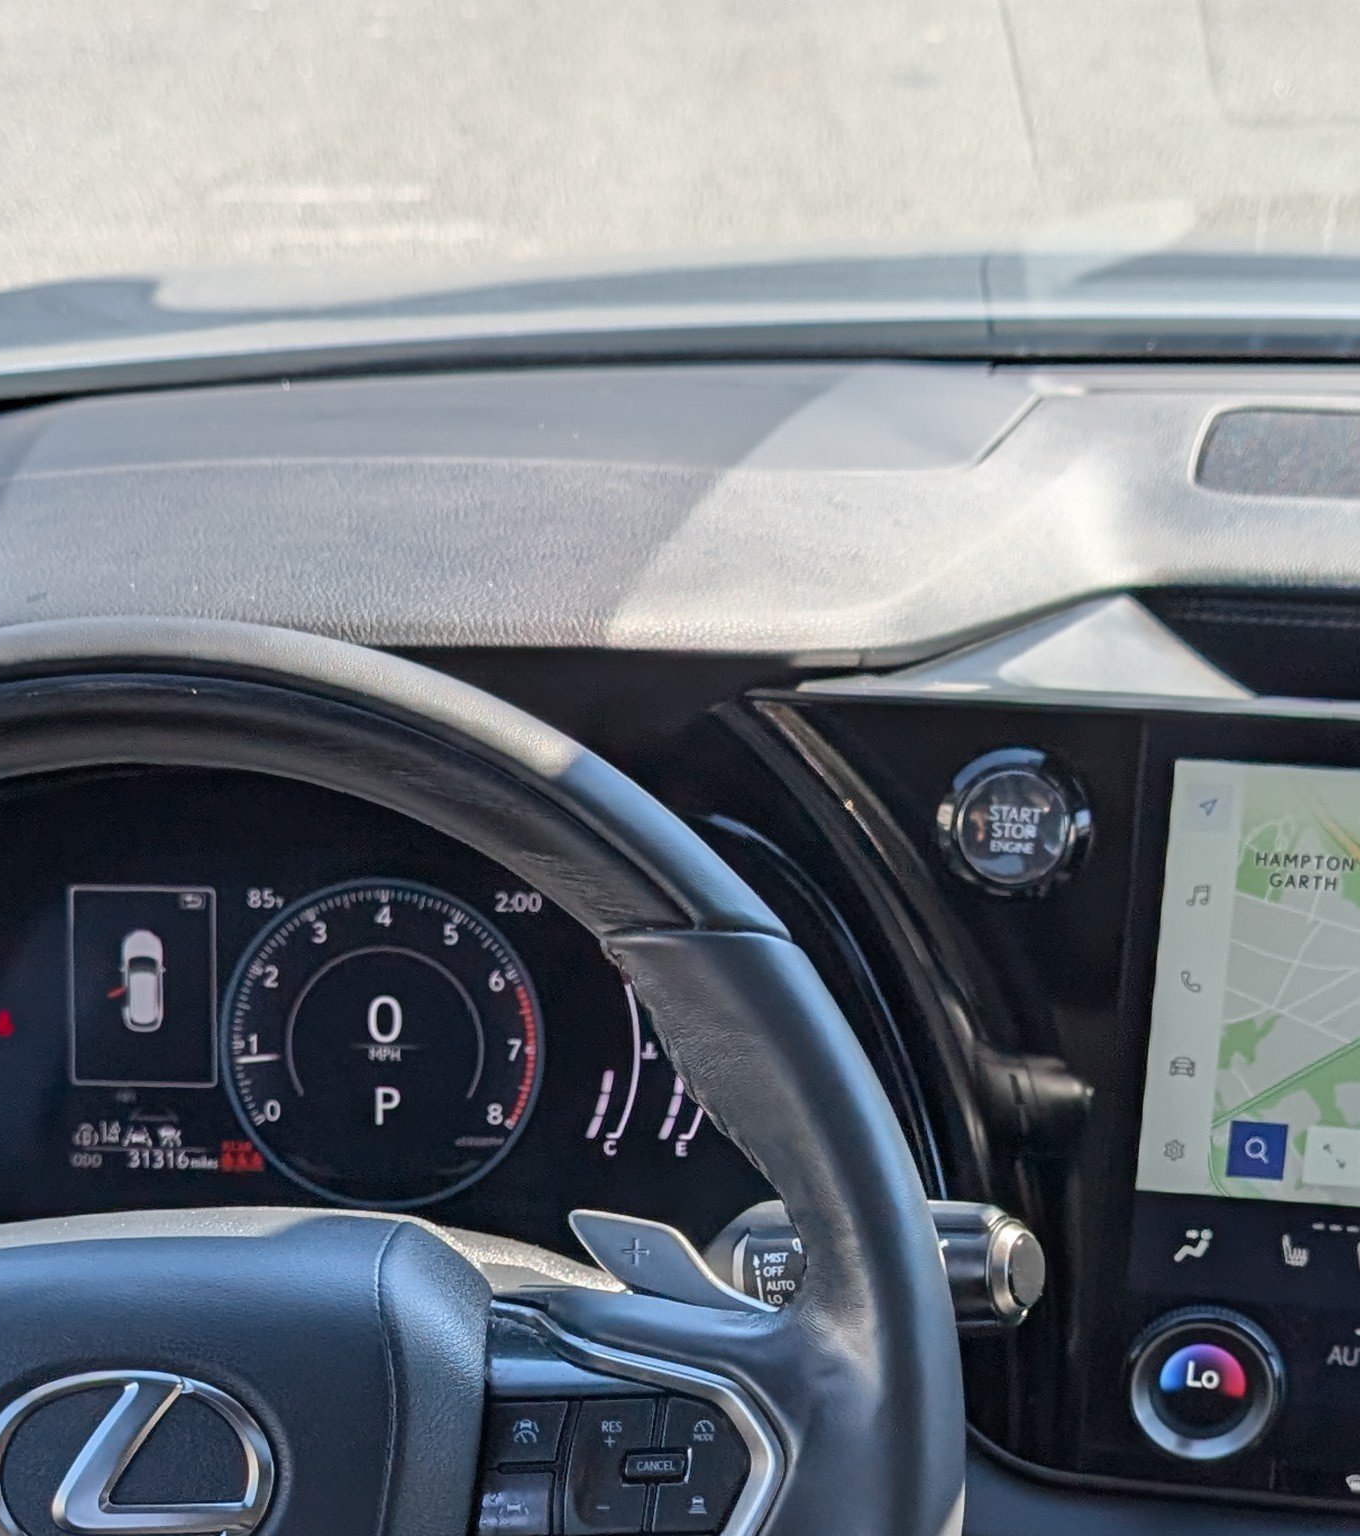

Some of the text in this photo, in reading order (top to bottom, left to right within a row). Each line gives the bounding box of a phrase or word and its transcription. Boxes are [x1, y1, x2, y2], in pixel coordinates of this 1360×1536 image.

[990, 805, 1041, 824] START
[991, 822, 1037, 840] STOP
[1255, 852, 1356, 872] HAMPTON
[1269, 873, 1338, 891] GARTH
[376, 908, 394, 927] 4
[311, 923, 329, 944] 3
[443, 924, 460, 945] 5
[263, 967, 280, 988] 2
[488, 970, 506, 992] 6
[367, 995, 402, 1043] 0
[246, 1034, 259, 1054] 1
[368, 1045, 401, 1061] MPH
[507, 1039, 521, 1060] 7
[263, 1099, 281, 1122] 0
[375, 1086, 401, 1126] P
[486, 1103, 504, 1126] 8
[603, 1140, 618, 1157] C
[675, 1140, 688, 1157] E
[127, 1150, 189, 1170] 31316
[762, 1252, 789, 1264] MIST
[762, 1265, 785, 1278] OFF
[766, 1279, 796, 1292] AUTO
[767, 1294, 784, 1305] LO
[1185, 1361, 1220, 1391] Lo
[601, 1420, 623, 1433] RES
[636, 1459, 676, 1473] CANCEL
